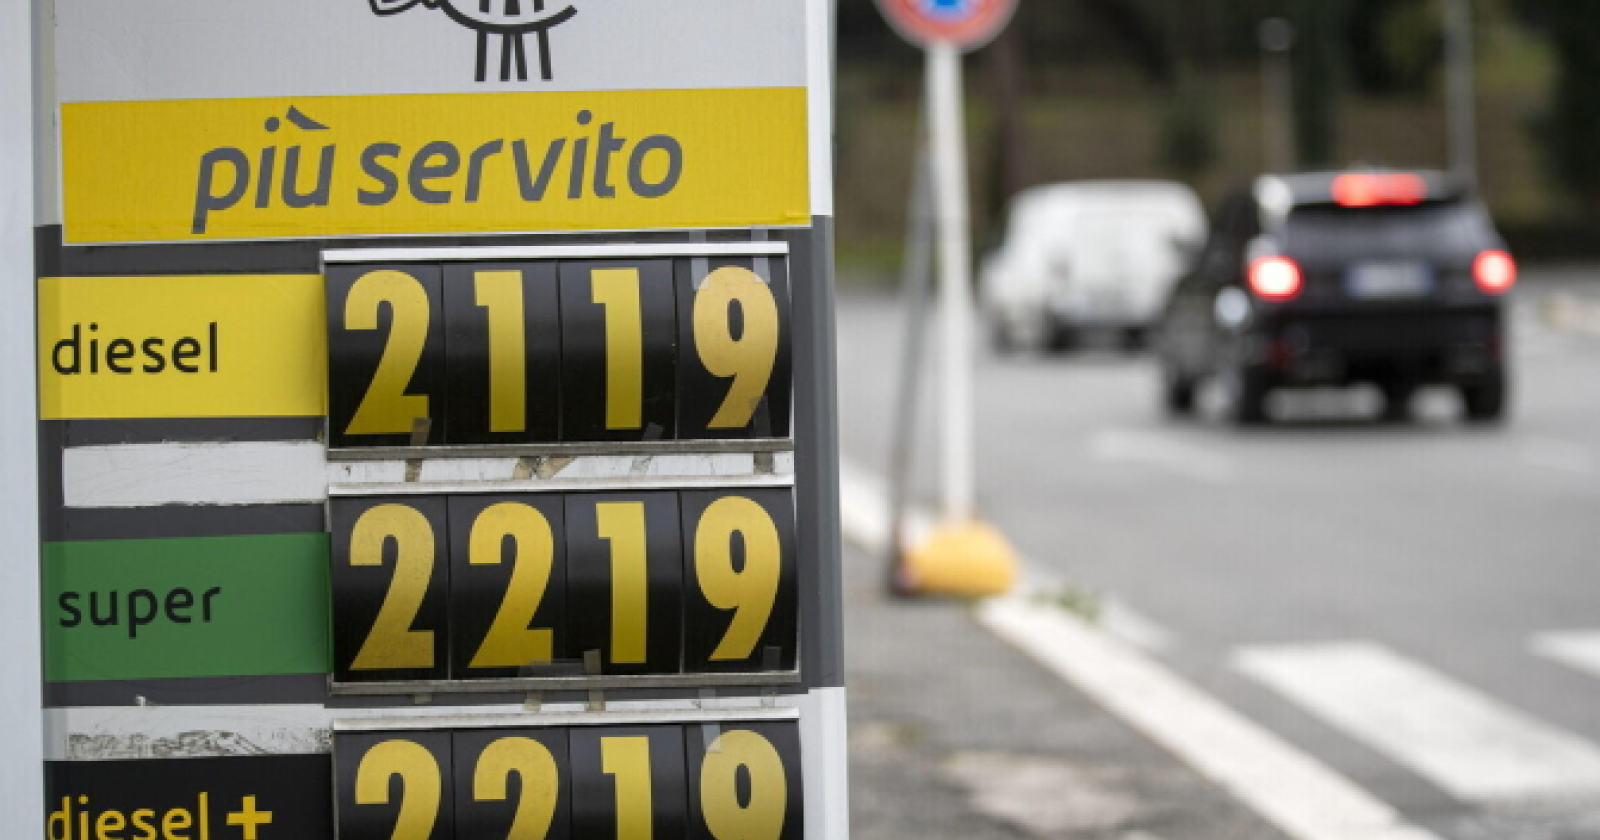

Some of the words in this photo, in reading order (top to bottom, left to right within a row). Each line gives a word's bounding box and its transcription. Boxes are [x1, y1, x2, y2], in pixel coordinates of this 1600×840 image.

[192, 105, 334, 233] più
[357, 109, 684, 206] servito
[51, 322, 219, 376] diesel
[343, 267, 779, 434] 2119
[58, 586, 220, 637] super
[349, 495, 781, 669] 2219
[46, 792, 210, 840] diesel
[354, 729, 788, 840] 2219
